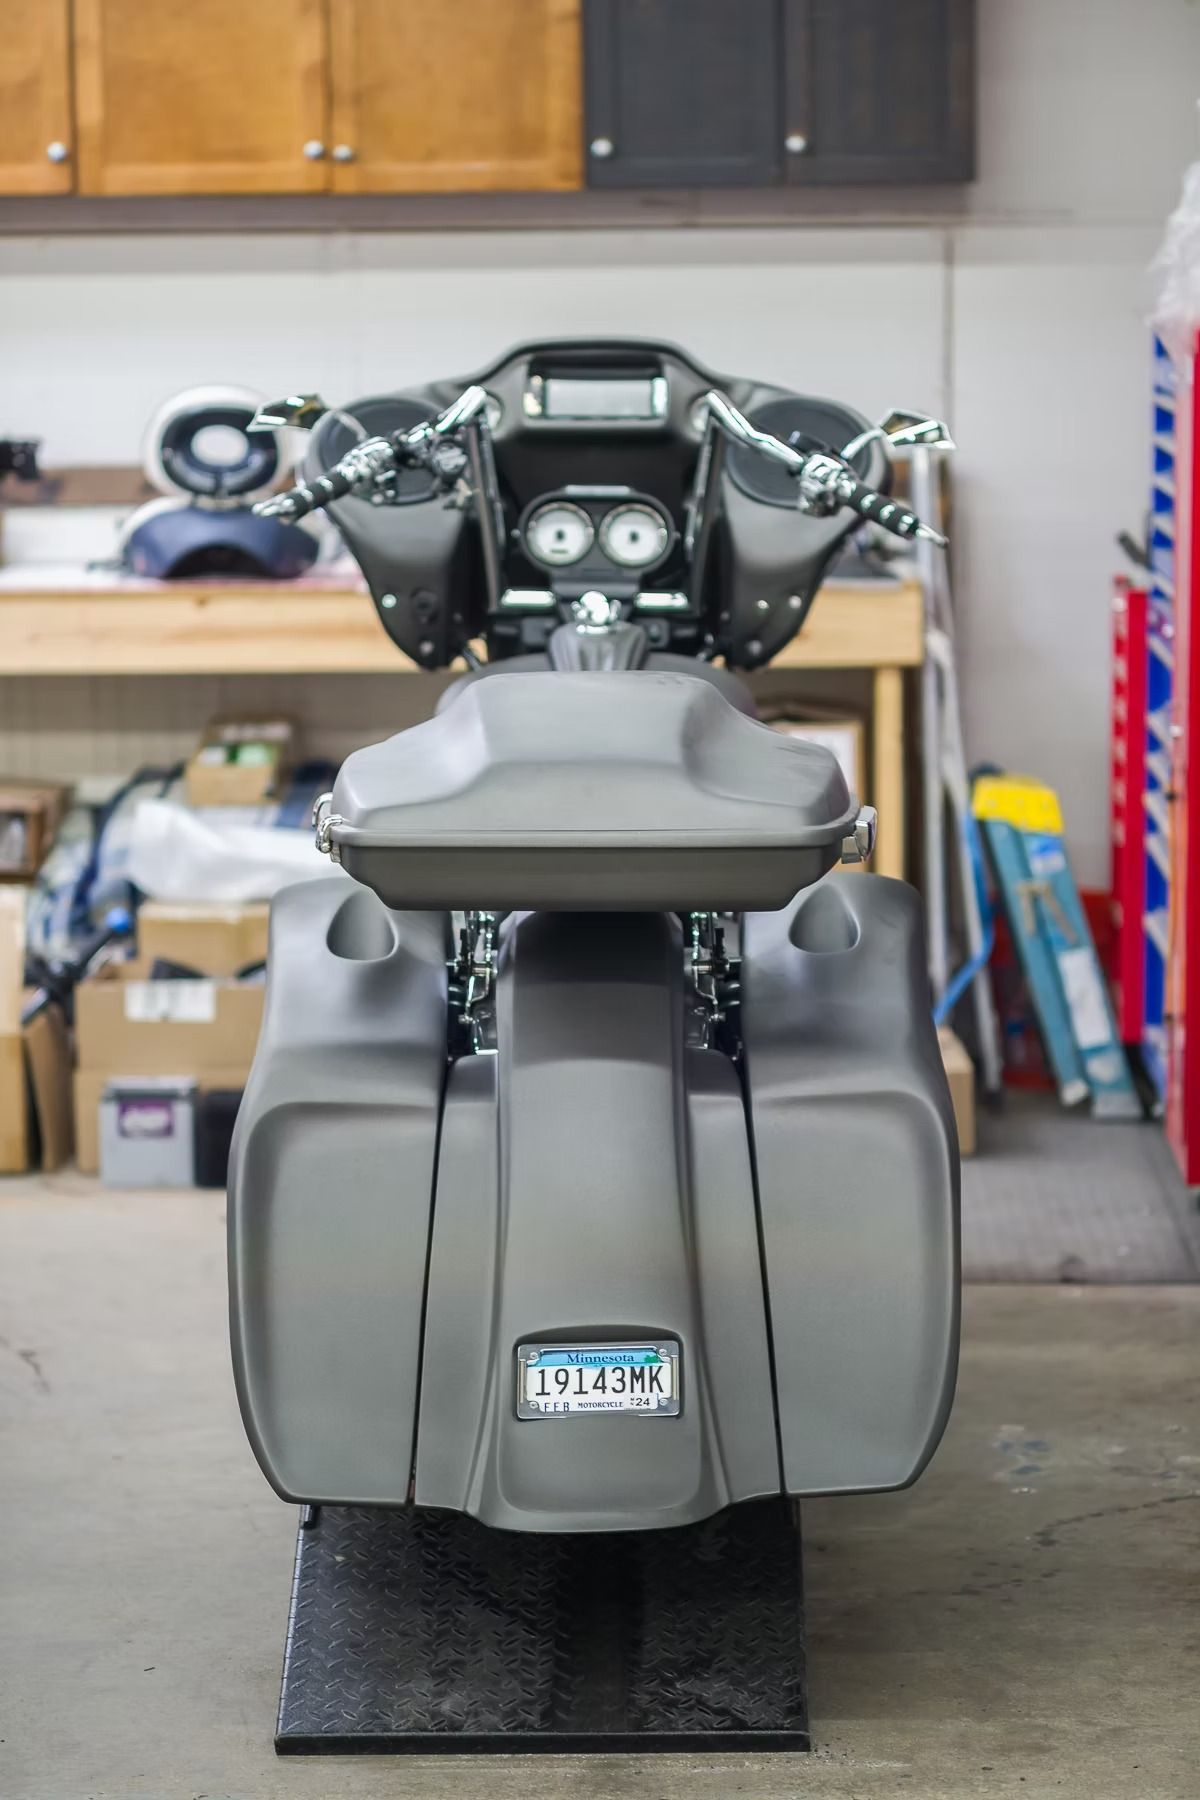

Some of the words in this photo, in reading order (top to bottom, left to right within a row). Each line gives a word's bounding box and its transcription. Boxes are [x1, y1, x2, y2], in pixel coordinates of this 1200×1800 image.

[567, 1353, 635, 1364] Minnesota
[535, 1366, 664, 1396] 19143MK
[544, 1402, 570, 1413] FEB
[577, 1401, 624, 1409] MOTORCYCLE
[635, 1398, 650, 1407] 24
